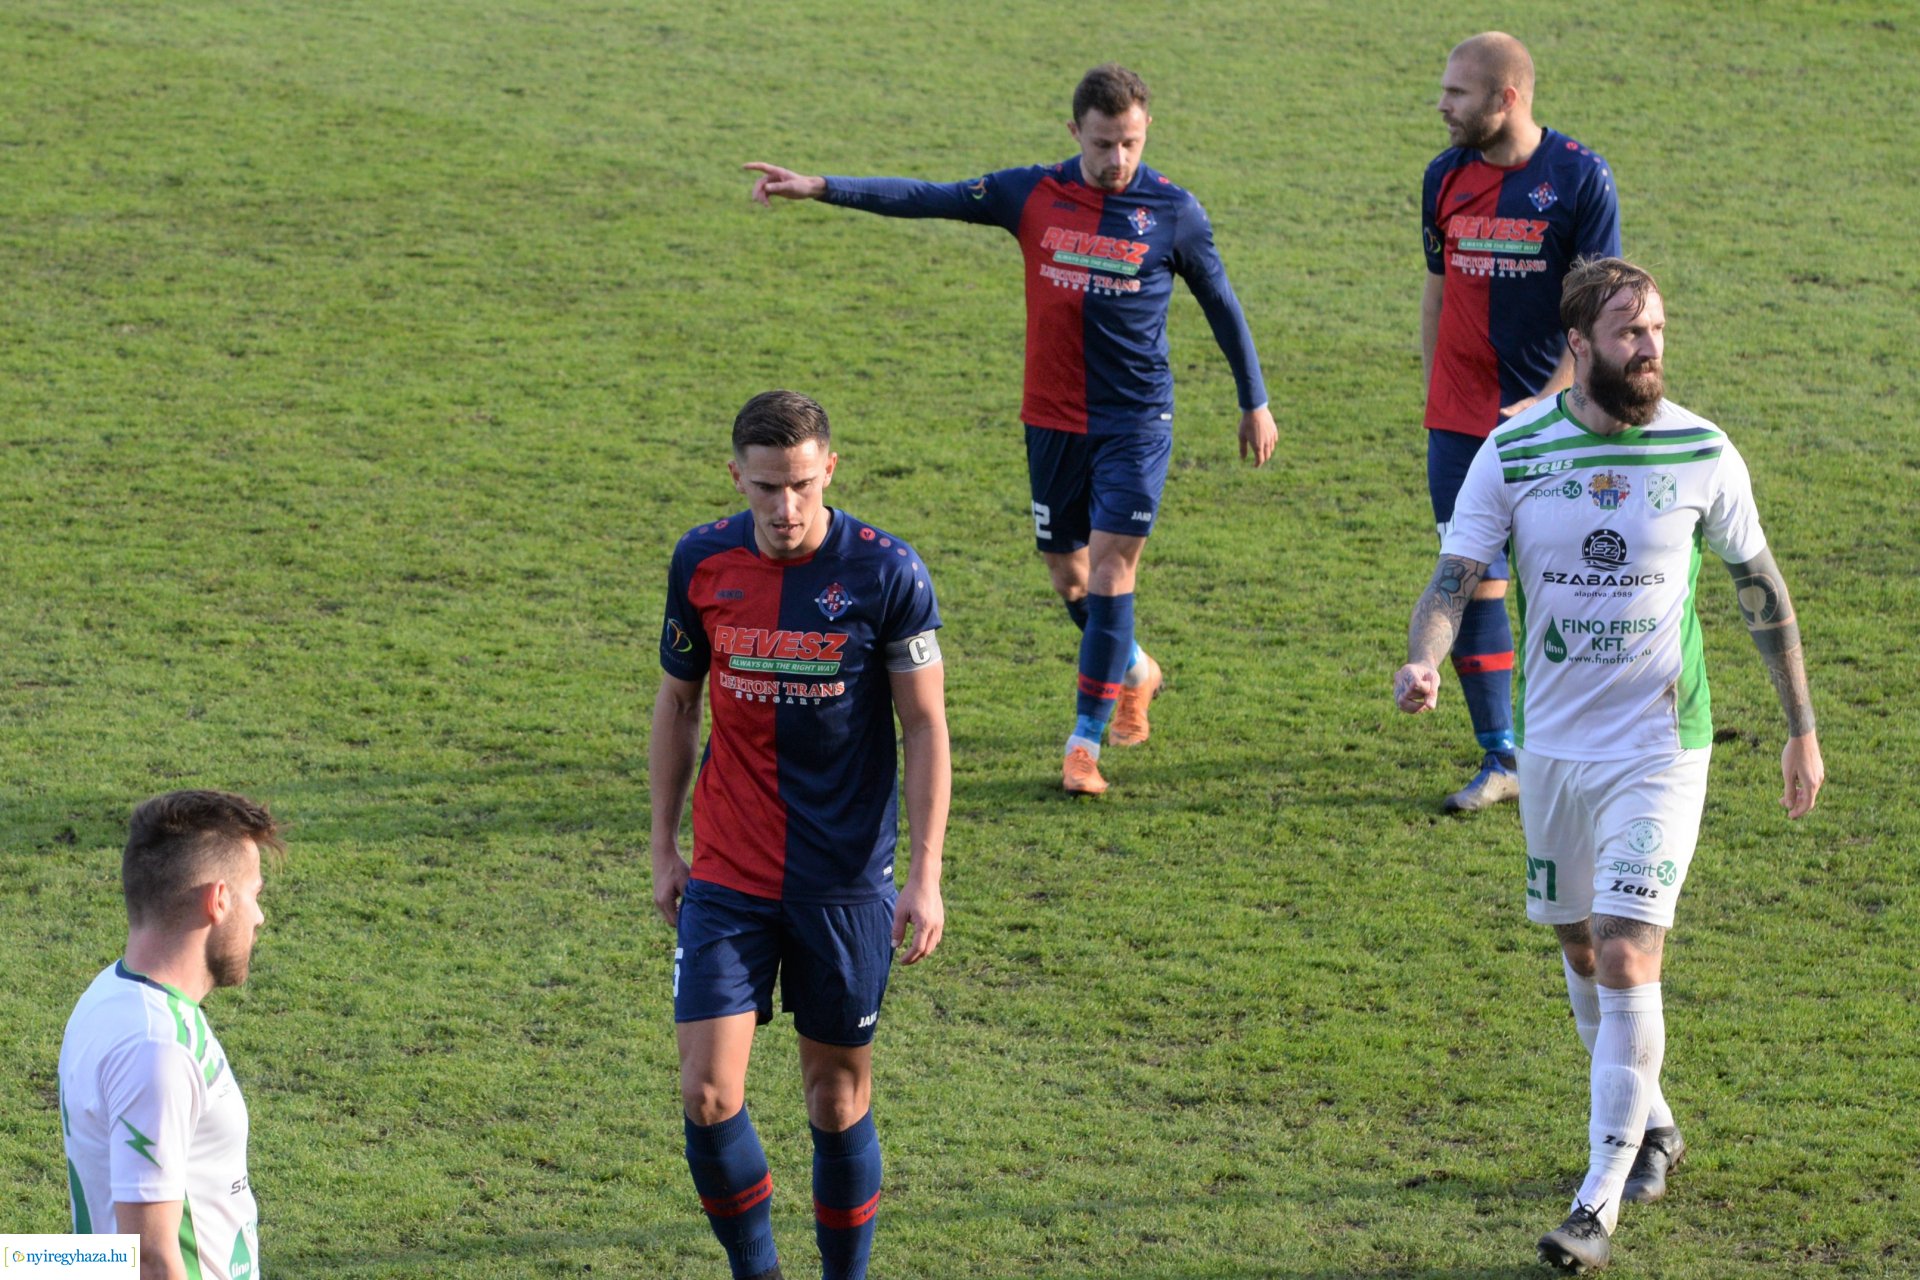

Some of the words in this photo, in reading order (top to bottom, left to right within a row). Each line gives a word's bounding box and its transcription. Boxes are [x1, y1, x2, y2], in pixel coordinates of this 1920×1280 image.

[1524, 458, 1573, 476] Zeus
[1542, 572, 1665, 587] SZABADICS
[1562, 618, 1605, 635] FINO
[1610, 618, 1657, 634] FRISS
[908, 636, 931, 665] C
[1592, 637, 1627, 652] KFT.
[732, 657, 761, 667] ALWAYS
[762, 661, 774, 669] ON
[776, 662, 790, 670] THE
[791, 663, 816, 672] RIGHT
[817, 665, 837, 673] WAY
[783, 681, 846, 698] TRANS
[735, 691, 822, 706] HUNGARY
[1610, 880, 1659, 899] Zeus
